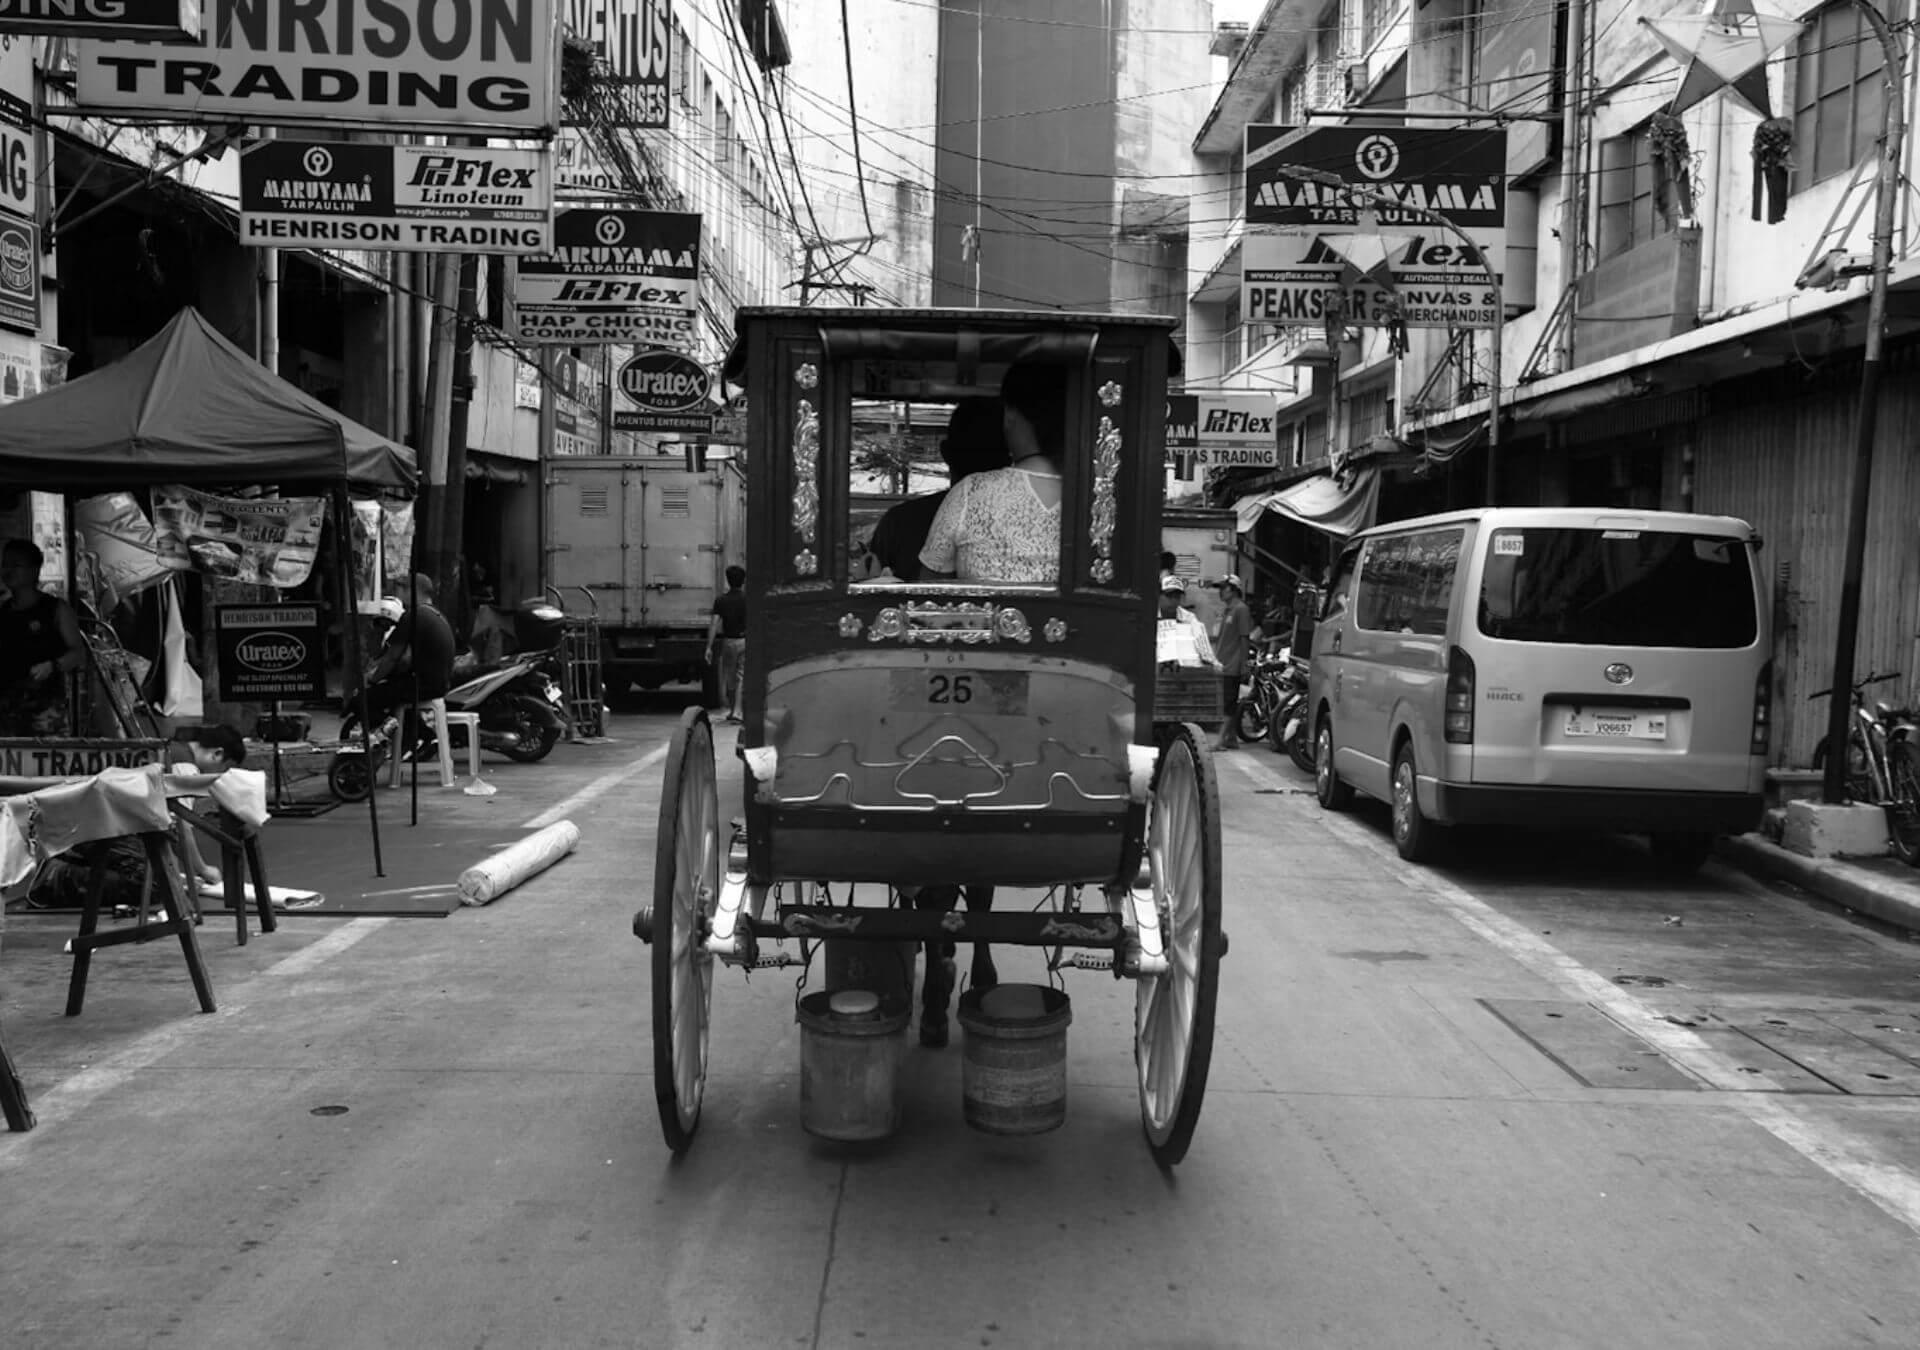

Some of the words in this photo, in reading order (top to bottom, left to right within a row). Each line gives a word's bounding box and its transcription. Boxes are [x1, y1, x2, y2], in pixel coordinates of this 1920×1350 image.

[97, 56, 532, 112] TRADING
[262, 179, 372, 202] MARUYAMA
[420, 188, 523, 206] Linoleum
[1254, 181, 1497, 211] MARUYAMA
[281, 200, 355, 211] TARPAULIN
[249, 218, 400, 242] HENRISON
[410, 225, 541, 247] TRADING
[562, 264, 654, 274] TARPAULIN
[1372, 291, 1473, 305] CNVAS
[1482, 292, 1496, 305] &
[520, 314, 576, 327] HAP
[585, 315, 692, 331] CHIONG
[520, 327, 638, 341] COMPANY,
[650, 397, 677, 406] FOAM
[616, 416, 656, 426] AVENTUS
[1212, 449, 1273, 464] TRADING
[223, 612, 272, 624] HENRISON
[273, 610, 314, 622] TRADING
[928, 674, 973, 704] 25
